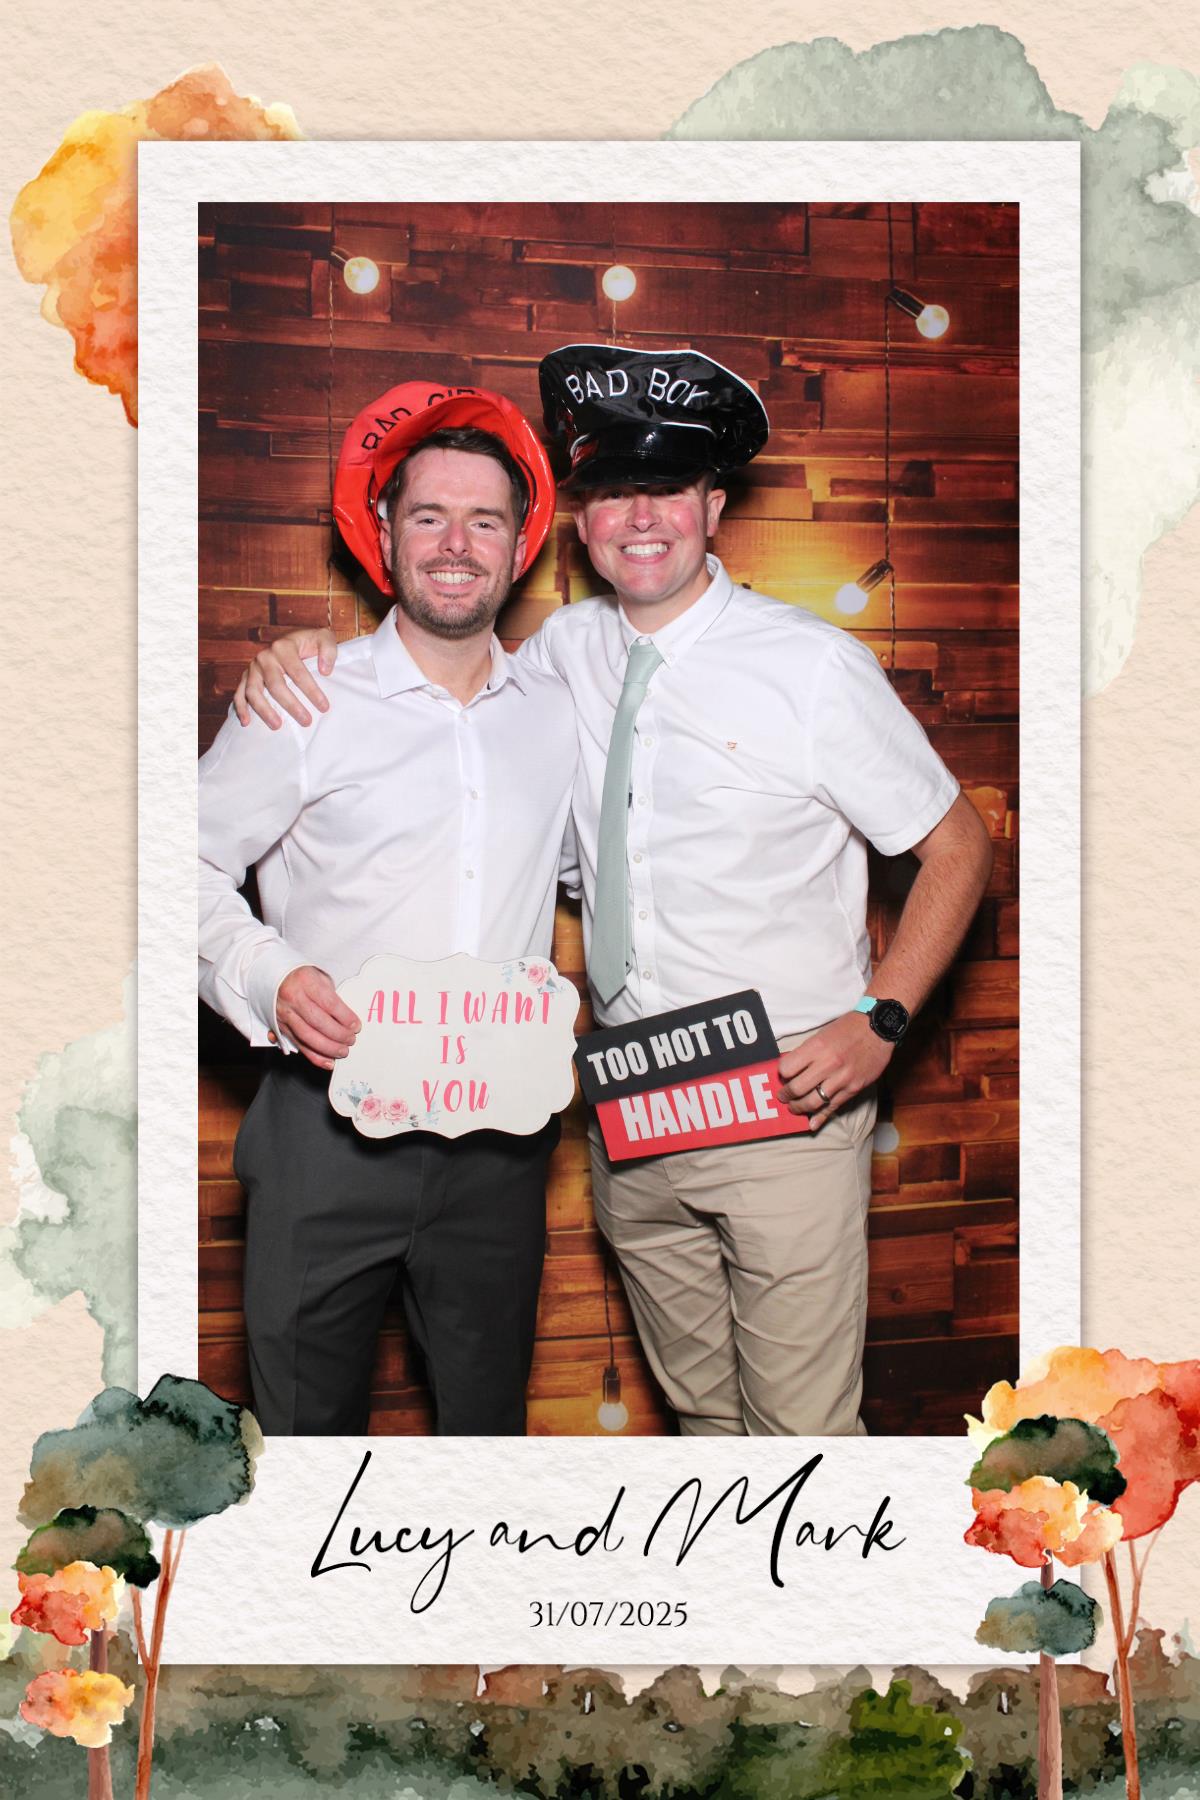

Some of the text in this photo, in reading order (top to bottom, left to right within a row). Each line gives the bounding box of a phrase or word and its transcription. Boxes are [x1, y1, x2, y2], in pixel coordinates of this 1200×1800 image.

[565, 367, 710, 406] BAD BOY
[367, 990, 424, 1025] ALL
[436, 991, 450, 1025] I
[439, 1034, 469, 1065] IS
[586, 1009, 758, 1086] TOO HOT TO
[422, 1079, 489, 1113] YOU
[618, 1073, 779, 1142] HANDLE
